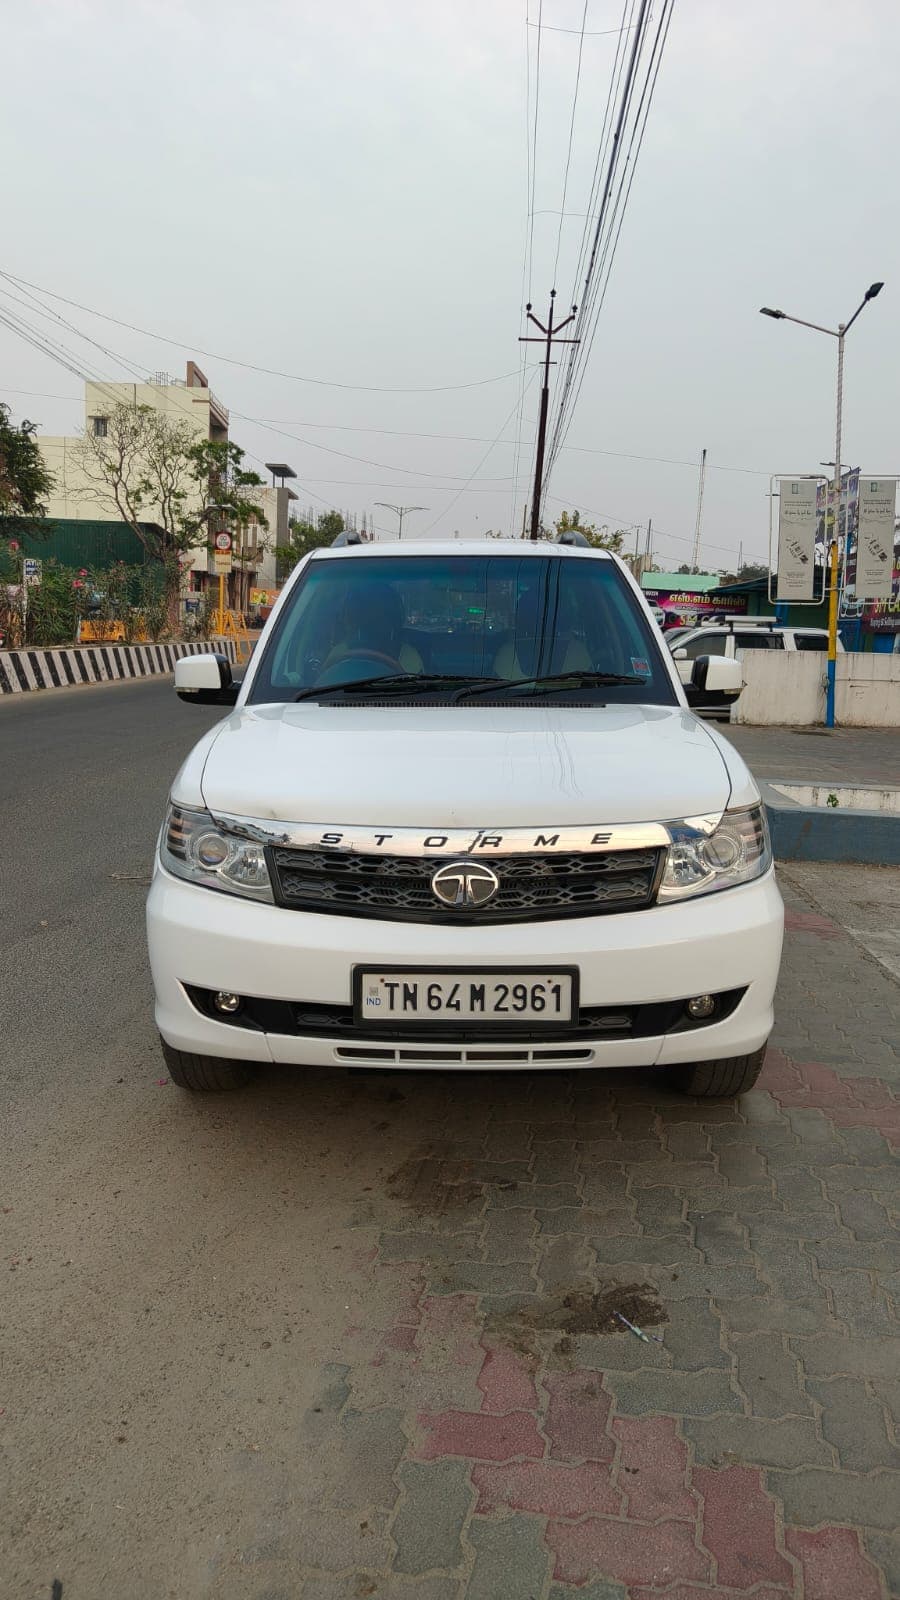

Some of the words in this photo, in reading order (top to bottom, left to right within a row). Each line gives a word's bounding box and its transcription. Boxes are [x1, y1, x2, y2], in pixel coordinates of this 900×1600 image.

[320, 832, 612, 849] STORME
[366, 997, 381, 1006] IND
[384, 982, 418, 1011] TN
[427, 983, 461, 1012] 64
[470, 983, 486, 1012] M
[494, 984, 561, 1012] 2961
